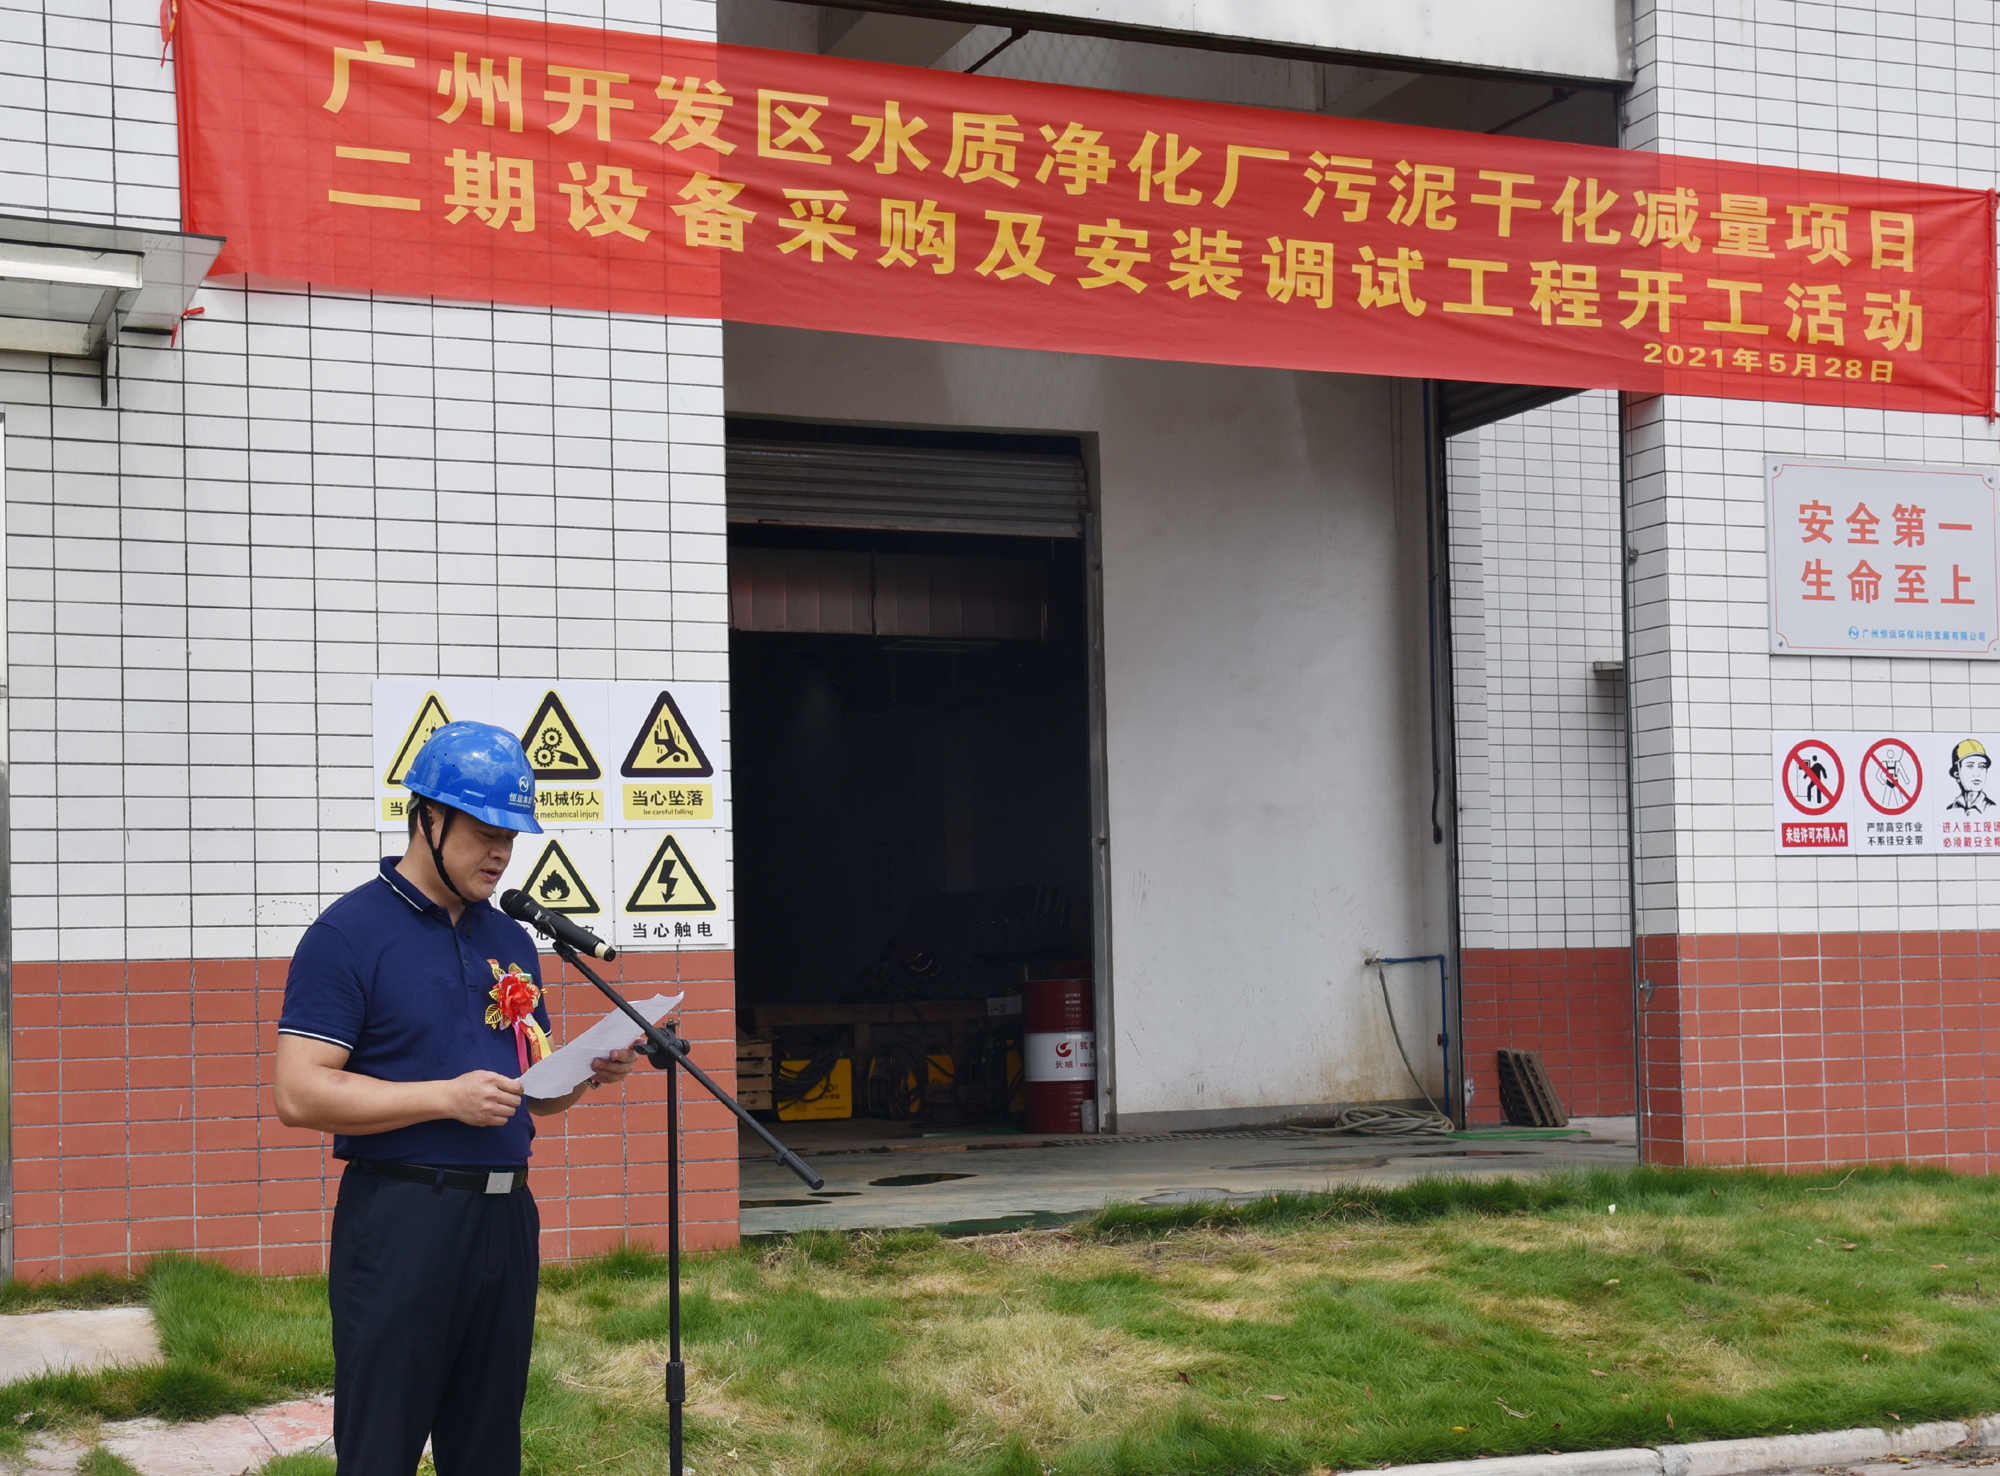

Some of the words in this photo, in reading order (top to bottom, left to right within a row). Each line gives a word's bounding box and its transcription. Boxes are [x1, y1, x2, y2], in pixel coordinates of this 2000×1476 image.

[323, 41, 1916, 273] 广州开发区水质净化厂污泥干化减量项目
[328, 146, 1923, 352] 二期设备采购及安装调试工程开工活动
[1643, 343, 1893, 383] 2021年5月28日
[1798, 499, 1973, 548] 安全第一
[1800, 558, 1976, 605] 生命至上
[632, 789, 704, 807] 当心坠落
[540, 810, 579, 819] mechanical
[580, 810, 600, 820] injury
[674, 808, 694, 816] falling
[1785, 826, 1846, 844] 未经许可不得入内
[1866, 821, 1923, 833] 严禁高空作业
[632, 921, 714, 939] 当心触电
[1055, 1060, 1074, 1069] 长城
